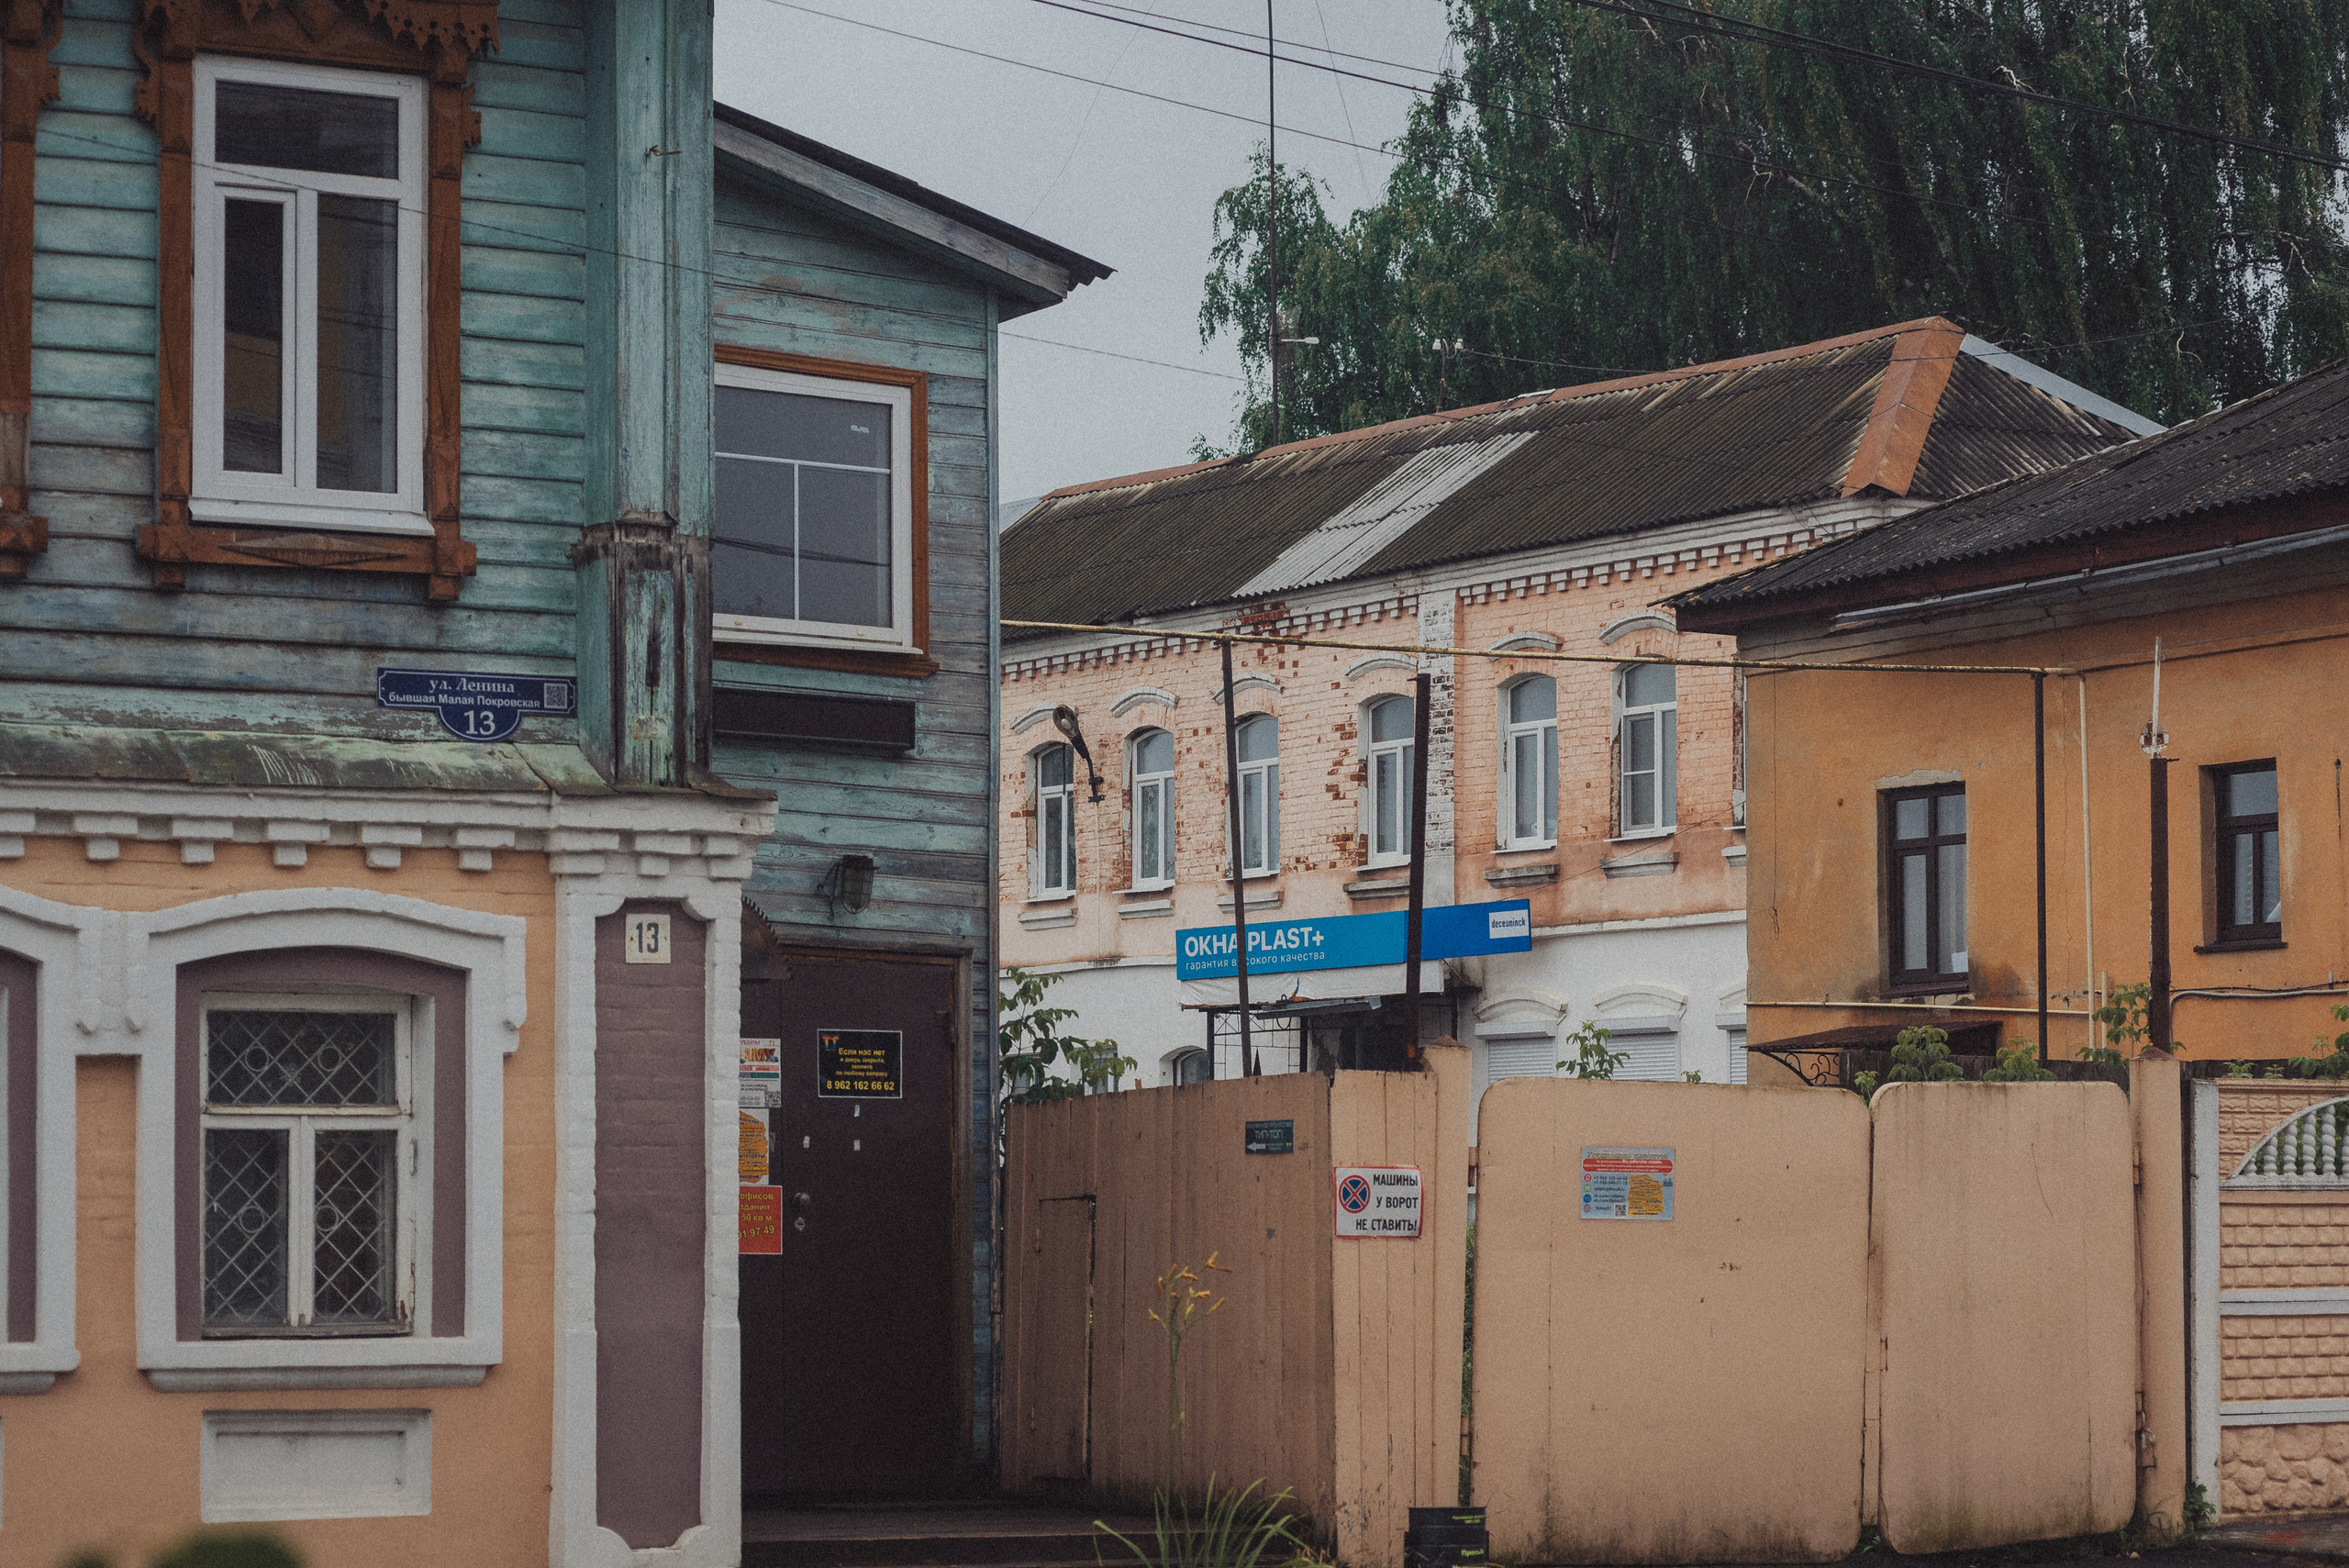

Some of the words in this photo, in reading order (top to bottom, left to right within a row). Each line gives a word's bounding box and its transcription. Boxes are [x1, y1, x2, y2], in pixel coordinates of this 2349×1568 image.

[429, 679, 452, 694] ул.
[455, 677, 516, 694] Ленина
[388, 692, 436, 704] бывшая
[438, 694, 475, 706] Малая
[476, 695, 540, 708] Покровская
[463, 710, 496, 735] 13
[1491, 917, 1526, 929] deceuninck
[636, 922, 660, 953] 13
[1185, 933, 1239, 958] ОКНА
[1247, 927, 1325, 952] PLAST+
[1186, 959, 1229, 972] гарантия
[1231, 954, 1277, 967] всокого
[1280, 951, 1325, 963] качества
[827, 1081, 832, 1090] 8
[834, 1081, 851, 1090] 962
[853, 1081, 869, 1090] 162
[871, 1081, 882, 1090] 66
[884, 1082, 895, 1091] 62
[1373, 1174, 1419, 1186] МАШИНЫ
[740, 1192, 774, 1201] офисов
[1376, 1196, 1383, 1208] У
[1386, 1196, 1419, 1209] ВОРОТ
[1355, 1218, 1367, 1230] НЕ
[1371, 1218, 1418, 1231] СТАВИТЬ!
[750, 1227, 761, 1238] 97
[763, 1225, 774, 1234] 49
